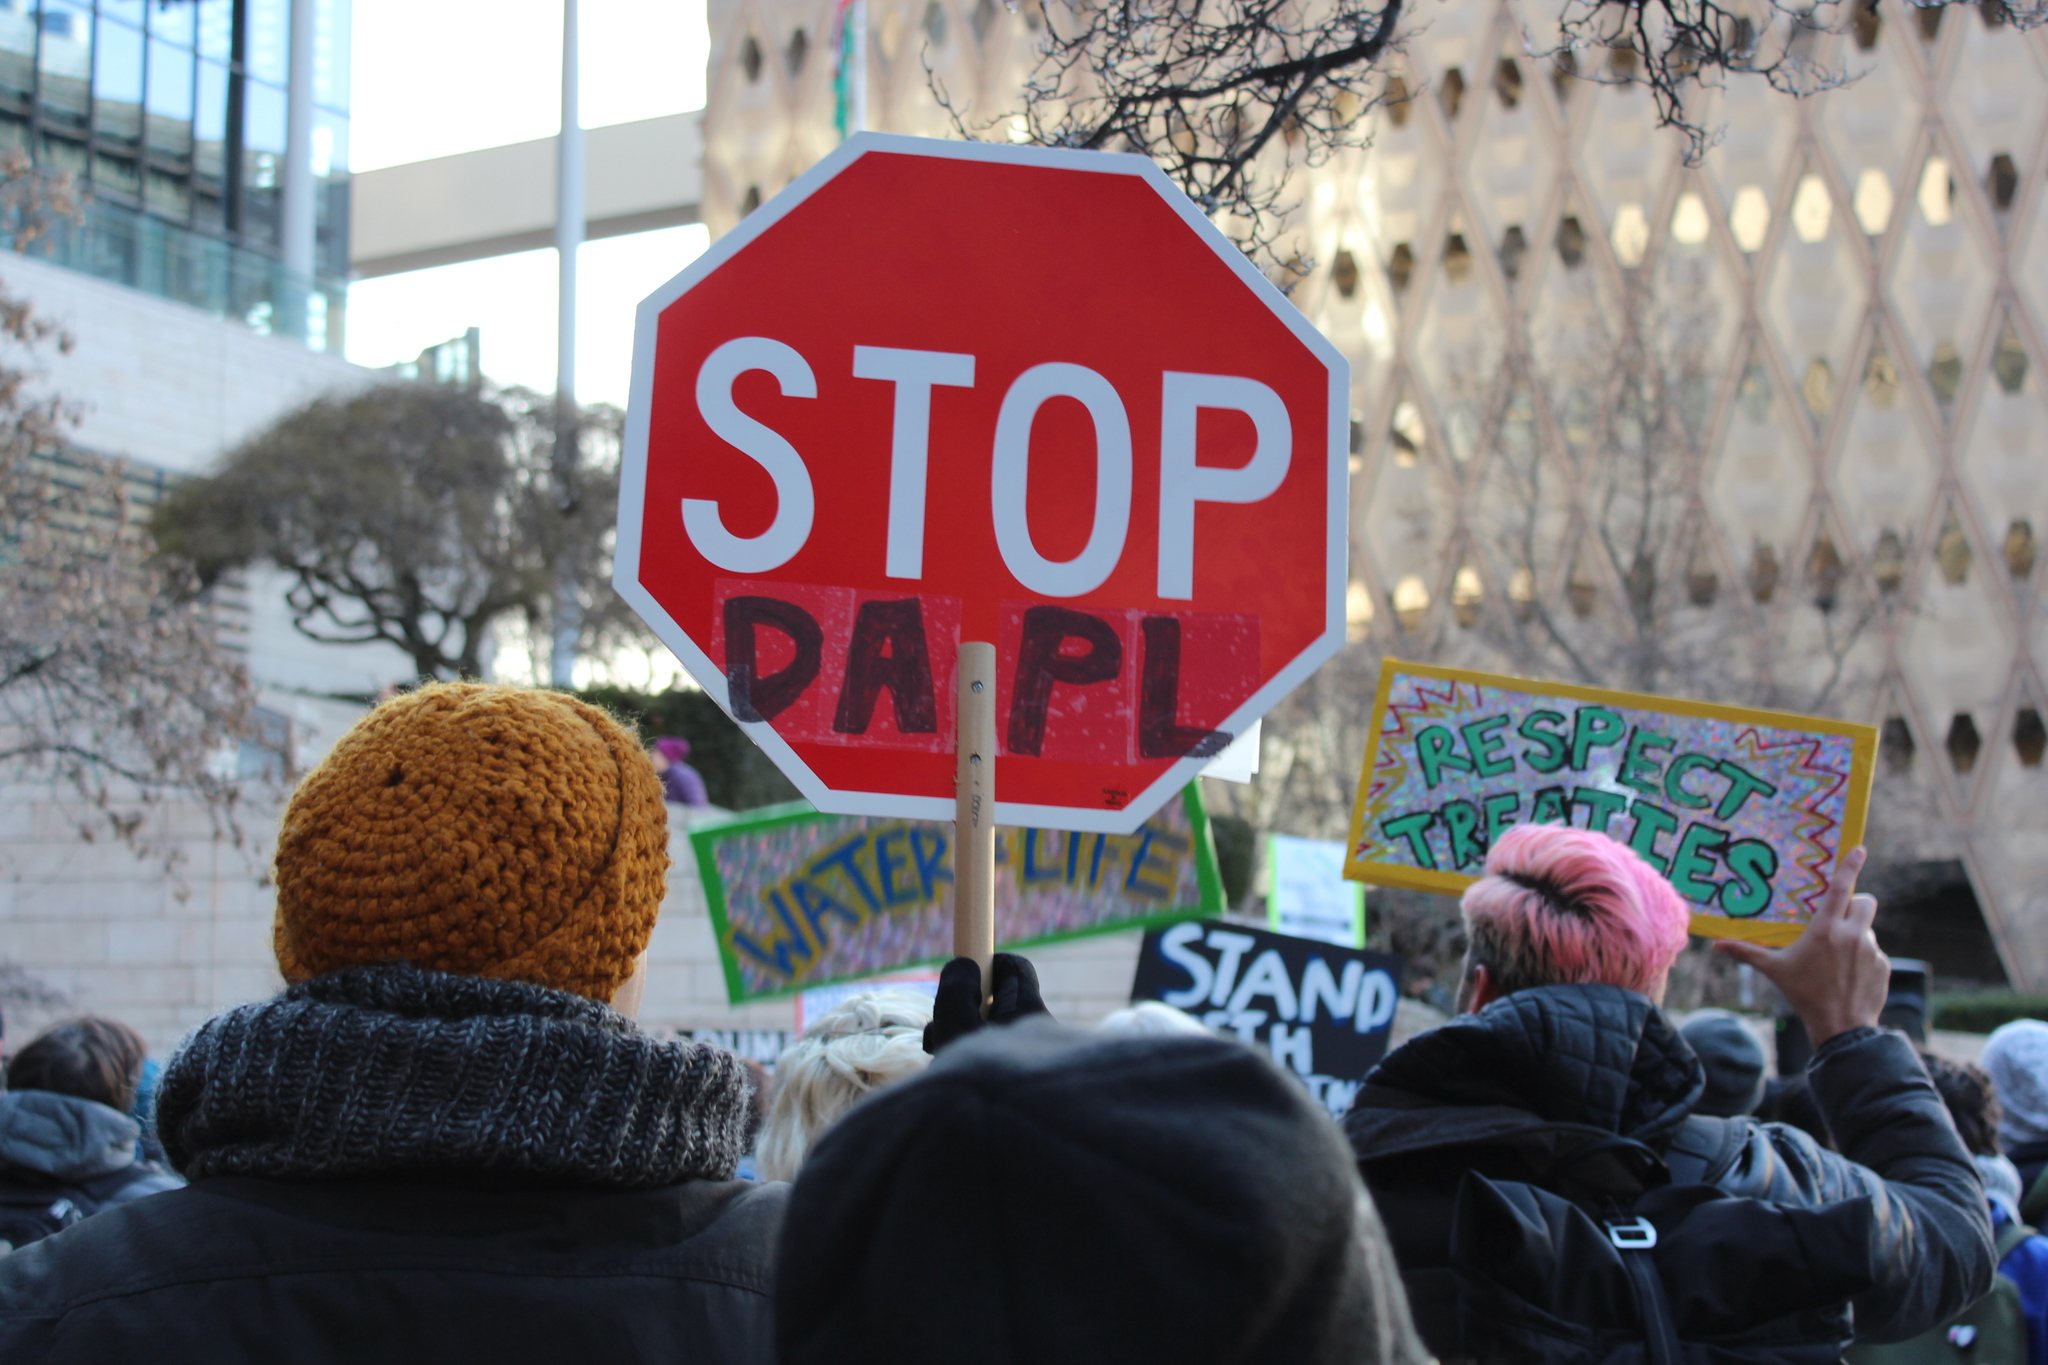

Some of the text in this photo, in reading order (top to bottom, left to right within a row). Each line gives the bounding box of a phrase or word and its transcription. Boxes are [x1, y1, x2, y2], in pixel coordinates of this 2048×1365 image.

[681, 335, 1293, 601] STOP
[722, 595, 1235, 758] DAPL
[1414, 706, 1777, 820] RESPECT
[728, 823, 956, 978] WATER
[1018, 827, 1190, 901] LIFE
[1381, 785, 1778, 918] TREATIES
[1159, 921, 1397, 1034] STAND
